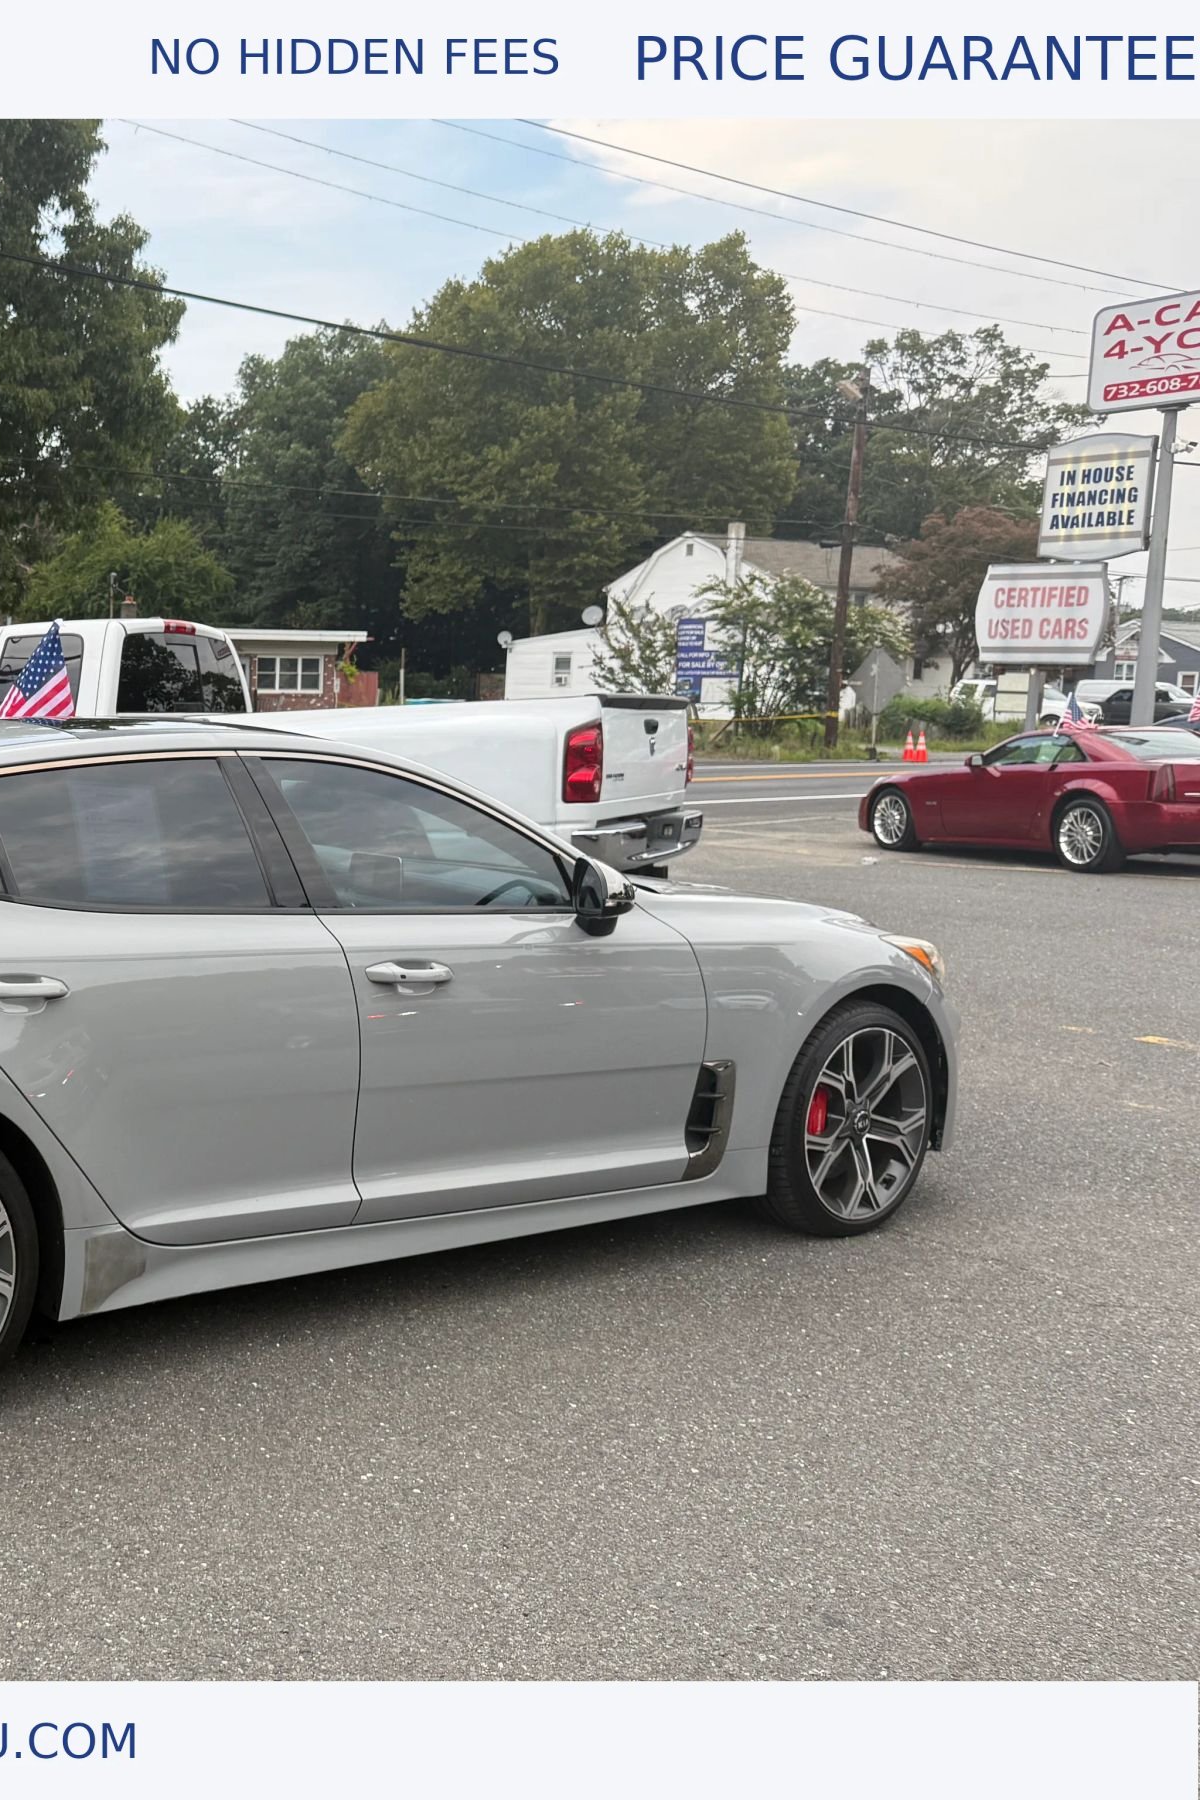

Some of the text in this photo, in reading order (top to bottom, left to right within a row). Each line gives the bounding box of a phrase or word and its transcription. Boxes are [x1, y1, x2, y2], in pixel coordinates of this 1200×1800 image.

[1106, 374, 1200, 400] 732-608-7
[1060, 465, 1135, 486] IN HOUSE
[1051, 487, 1138, 509] FINANCING
[1049, 510, 1135, 530] AVAILABLE
[994, 586, 1089, 608] CERTIFIED
[987, 618, 1089, 640] USED CARS
[678, 661, 690, 669] FOR
[691, 661, 706, 669] SALE
